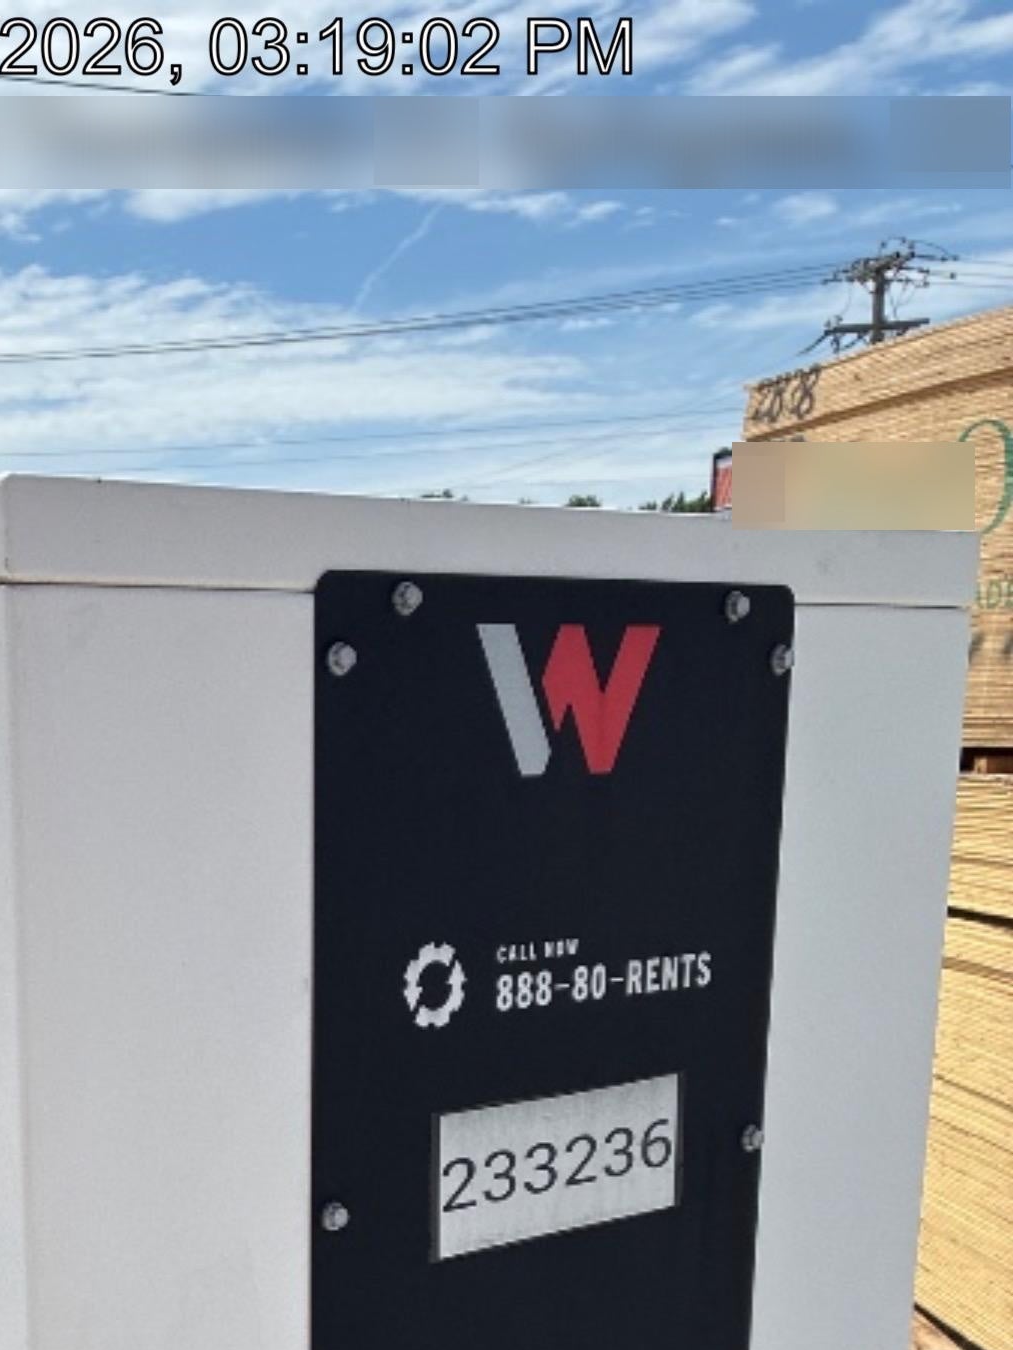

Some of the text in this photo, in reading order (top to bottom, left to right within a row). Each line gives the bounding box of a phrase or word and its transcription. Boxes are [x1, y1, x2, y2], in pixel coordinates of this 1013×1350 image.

[495, 938, 580, 964] CALL NOW
[495, 951, 712, 1012] 888-80-RENTS
[441, 1118, 673, 1213] 233236
